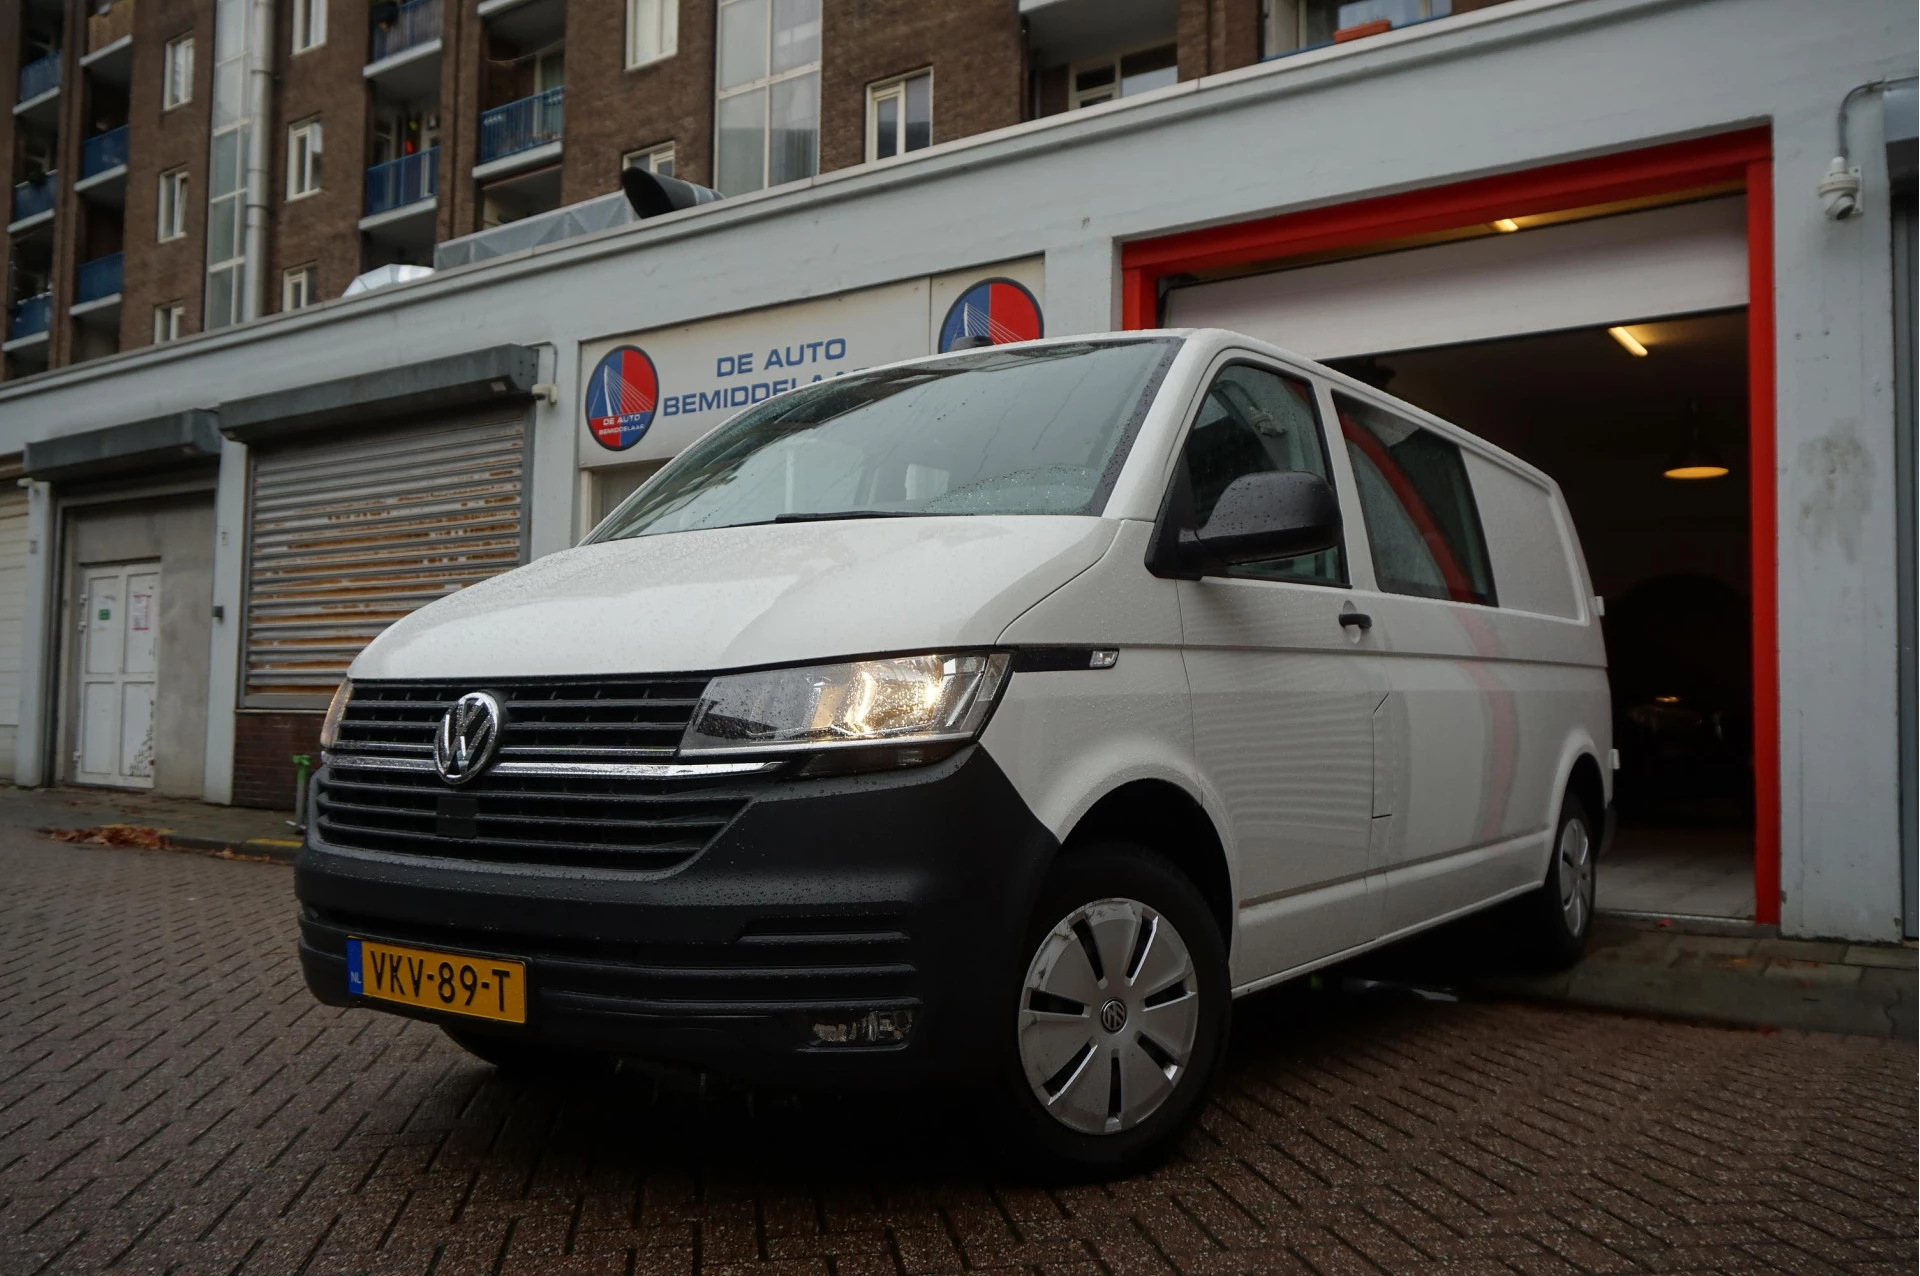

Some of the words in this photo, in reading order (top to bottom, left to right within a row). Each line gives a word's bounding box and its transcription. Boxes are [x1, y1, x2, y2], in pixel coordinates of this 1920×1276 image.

[717, 353, 754, 378] DE
[764, 338, 846, 370] AUTO
[663, 367, 869, 417] BEMIDDE
[603, 418, 615, 426] DE
[617, 414, 641, 423] AUTO
[350, 971, 362, 984] NL
[370, 951, 511, 1013] VKV-89-T
